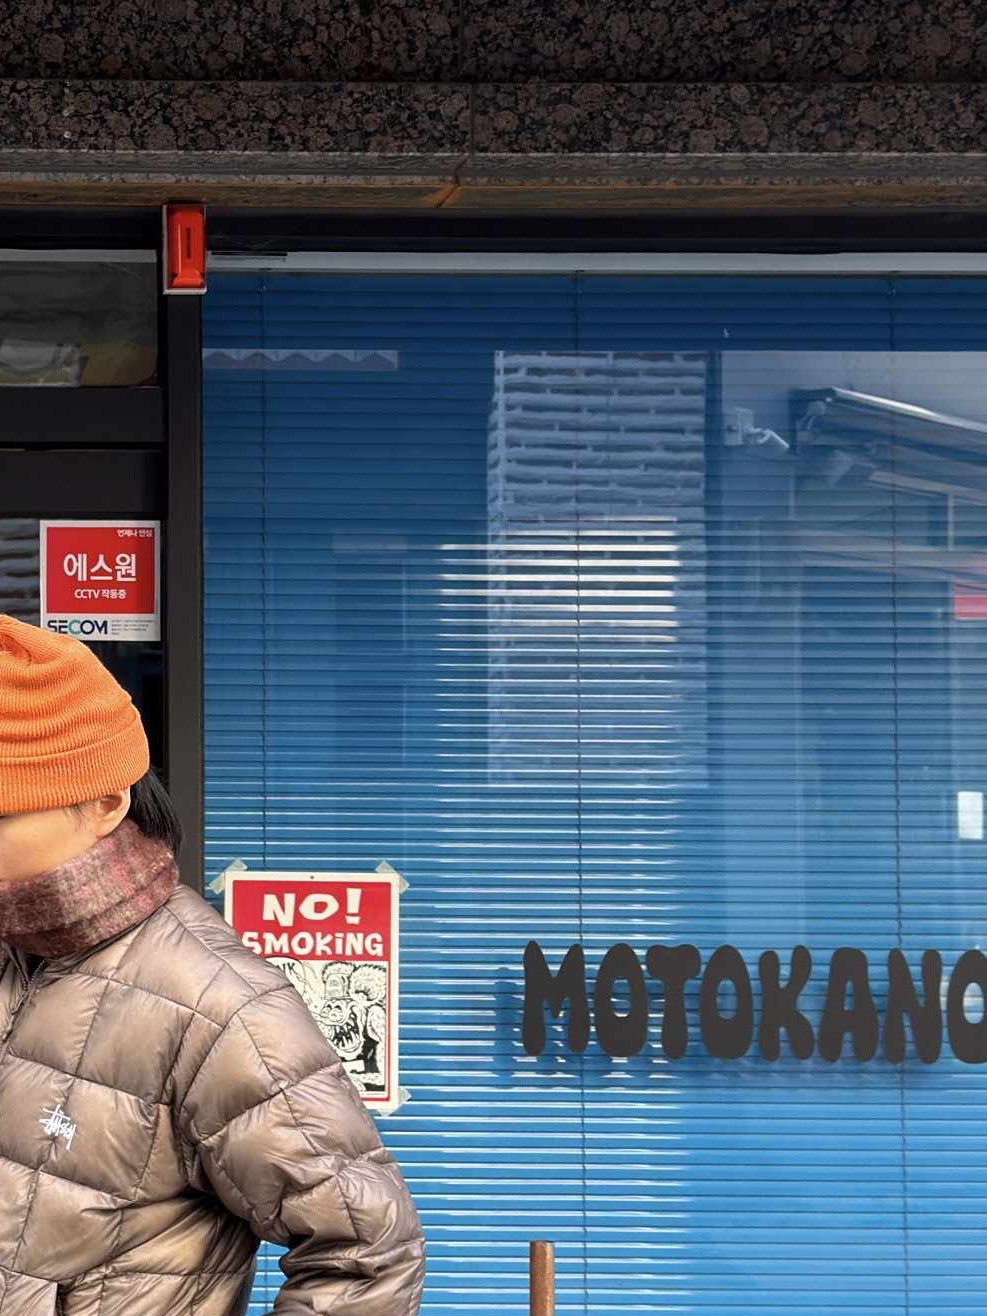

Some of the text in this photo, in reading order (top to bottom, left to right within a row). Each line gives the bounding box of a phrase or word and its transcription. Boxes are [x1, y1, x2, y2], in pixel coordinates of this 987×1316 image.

[63, 553, 137, 582] 에스원
[74, 589, 127, 599] CCTV 작동중
[47, 619, 108, 635] SECOM
[263, 888, 362, 927] NO!
[522, 939, 987, 1065] MOTOKANO
